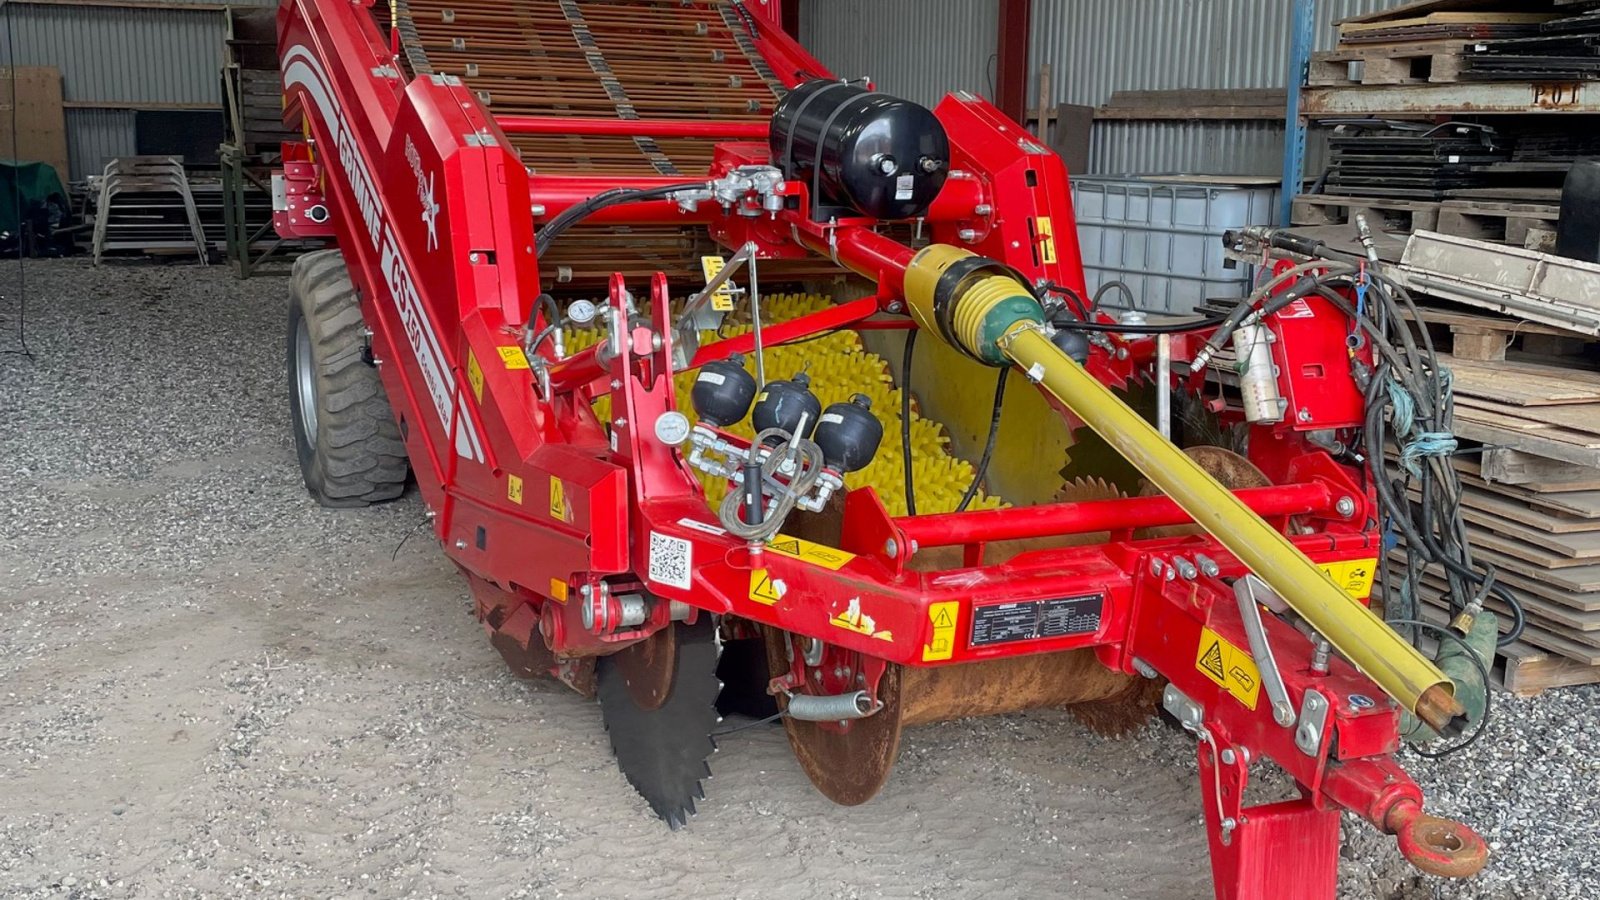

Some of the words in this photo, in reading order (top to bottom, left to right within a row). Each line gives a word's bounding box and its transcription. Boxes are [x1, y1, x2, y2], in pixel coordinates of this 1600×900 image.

[340, 129, 381, 253] GRIMME
[392, 254, 407, 313] CS
[406, 313, 421, 353] 150
